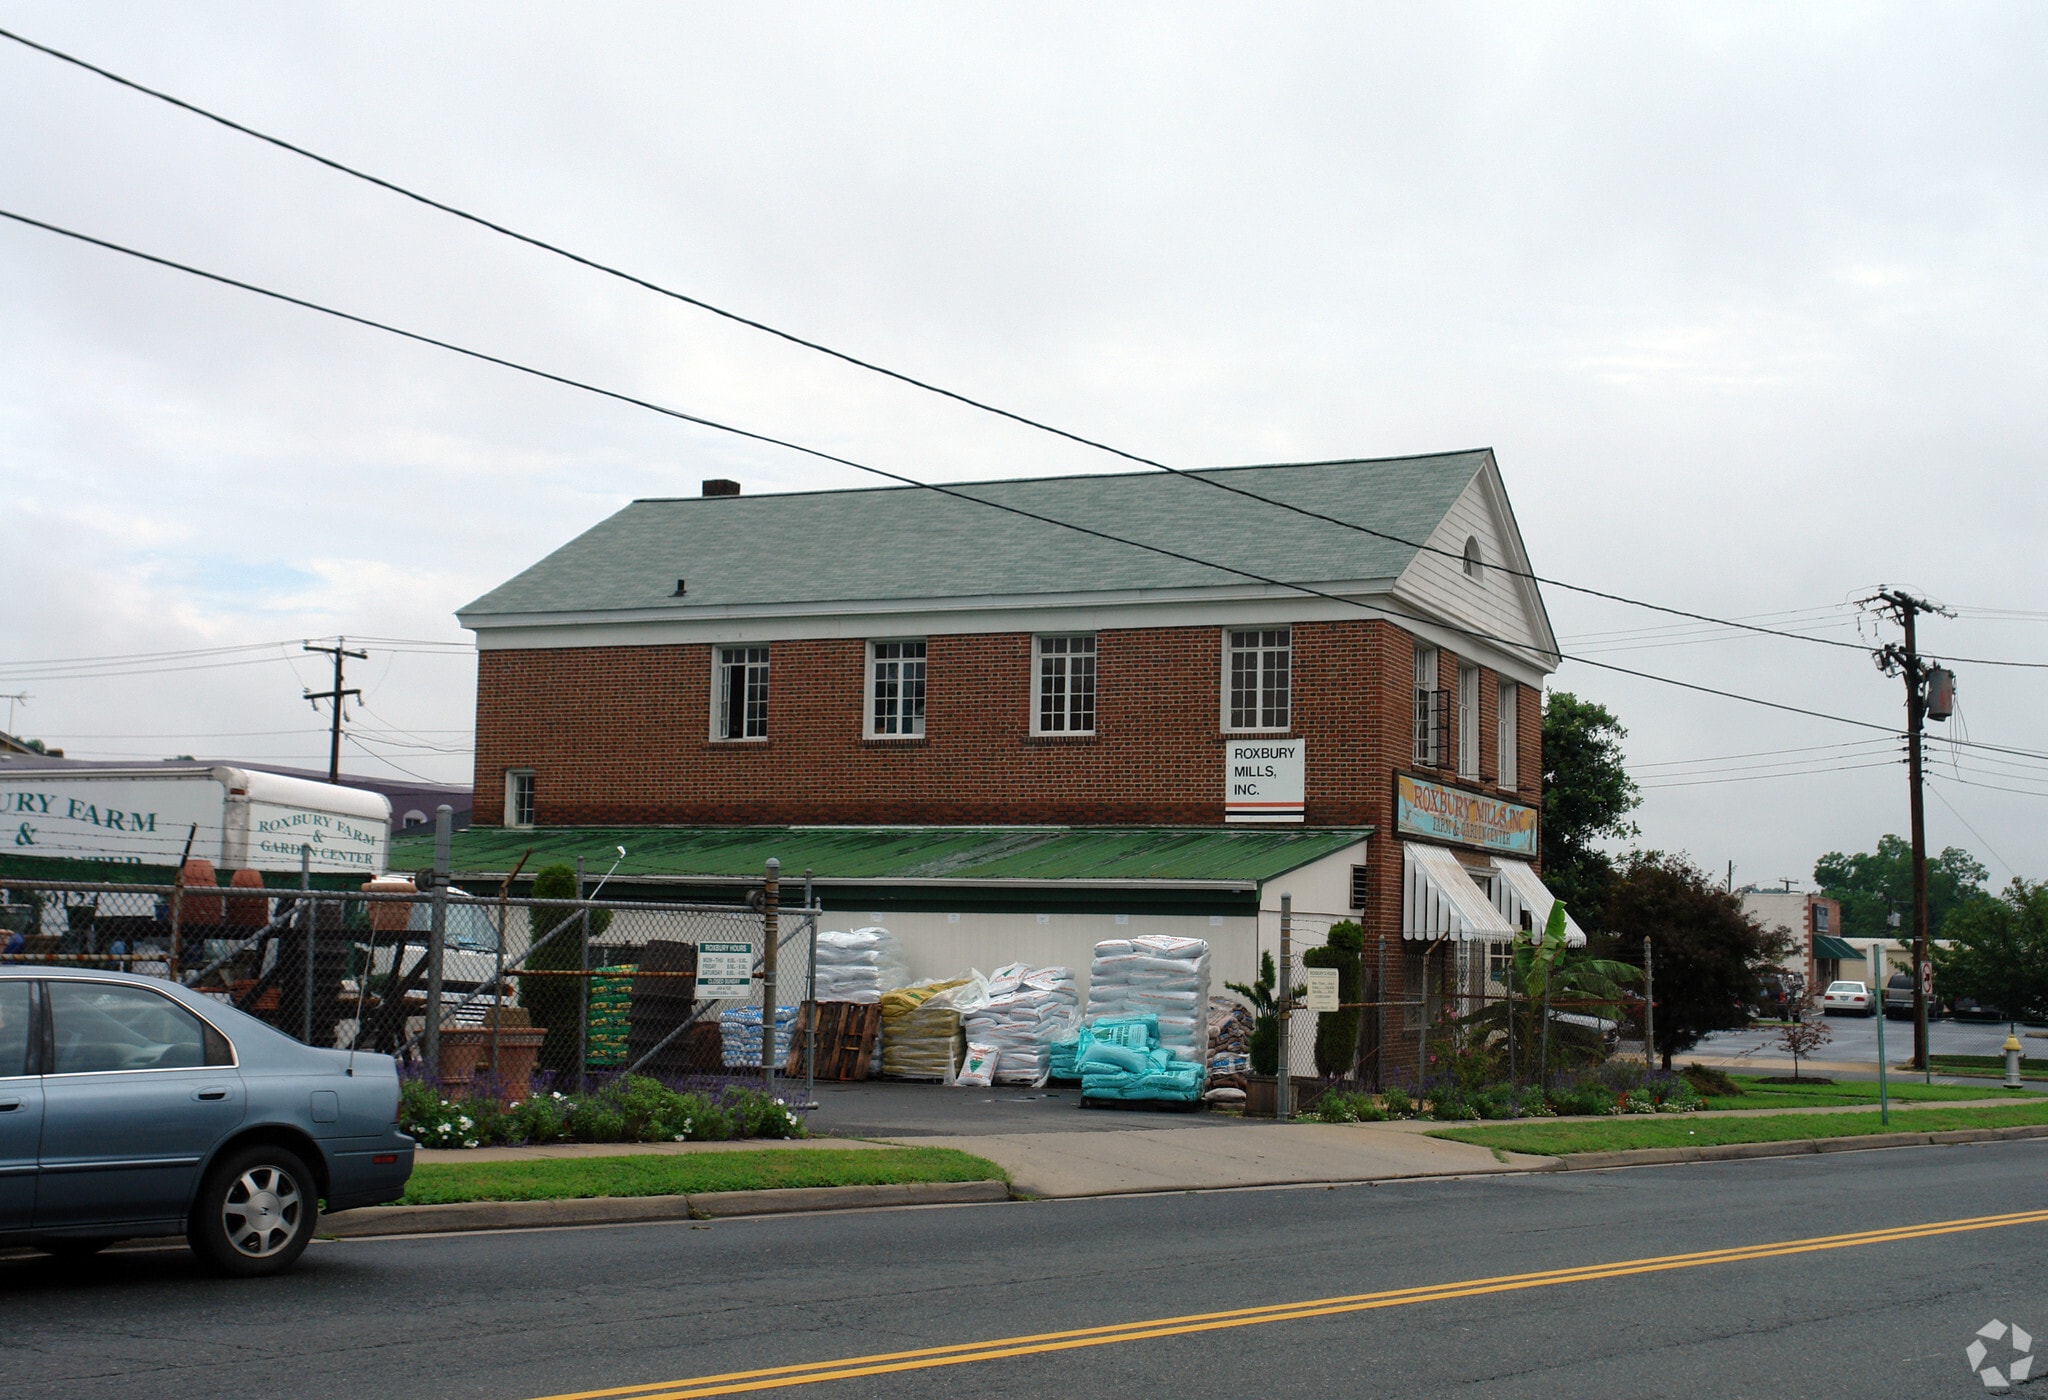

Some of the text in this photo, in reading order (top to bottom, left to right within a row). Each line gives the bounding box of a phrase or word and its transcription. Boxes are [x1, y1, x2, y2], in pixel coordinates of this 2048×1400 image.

[1234, 747, 1296, 760] ROXBURY
[1234, 765, 1277, 779] MILLS,
[1234, 783, 1260, 796] INC.
[1413, 785, 1471, 819] ROXBURY
[66, 798, 158, 832] FARM
[15, 821, 37, 846] &
[259, 814, 376, 846] ROXBURY FARM
[312, 829, 324, 843] &
[320, 848, 373, 865] CENTER
